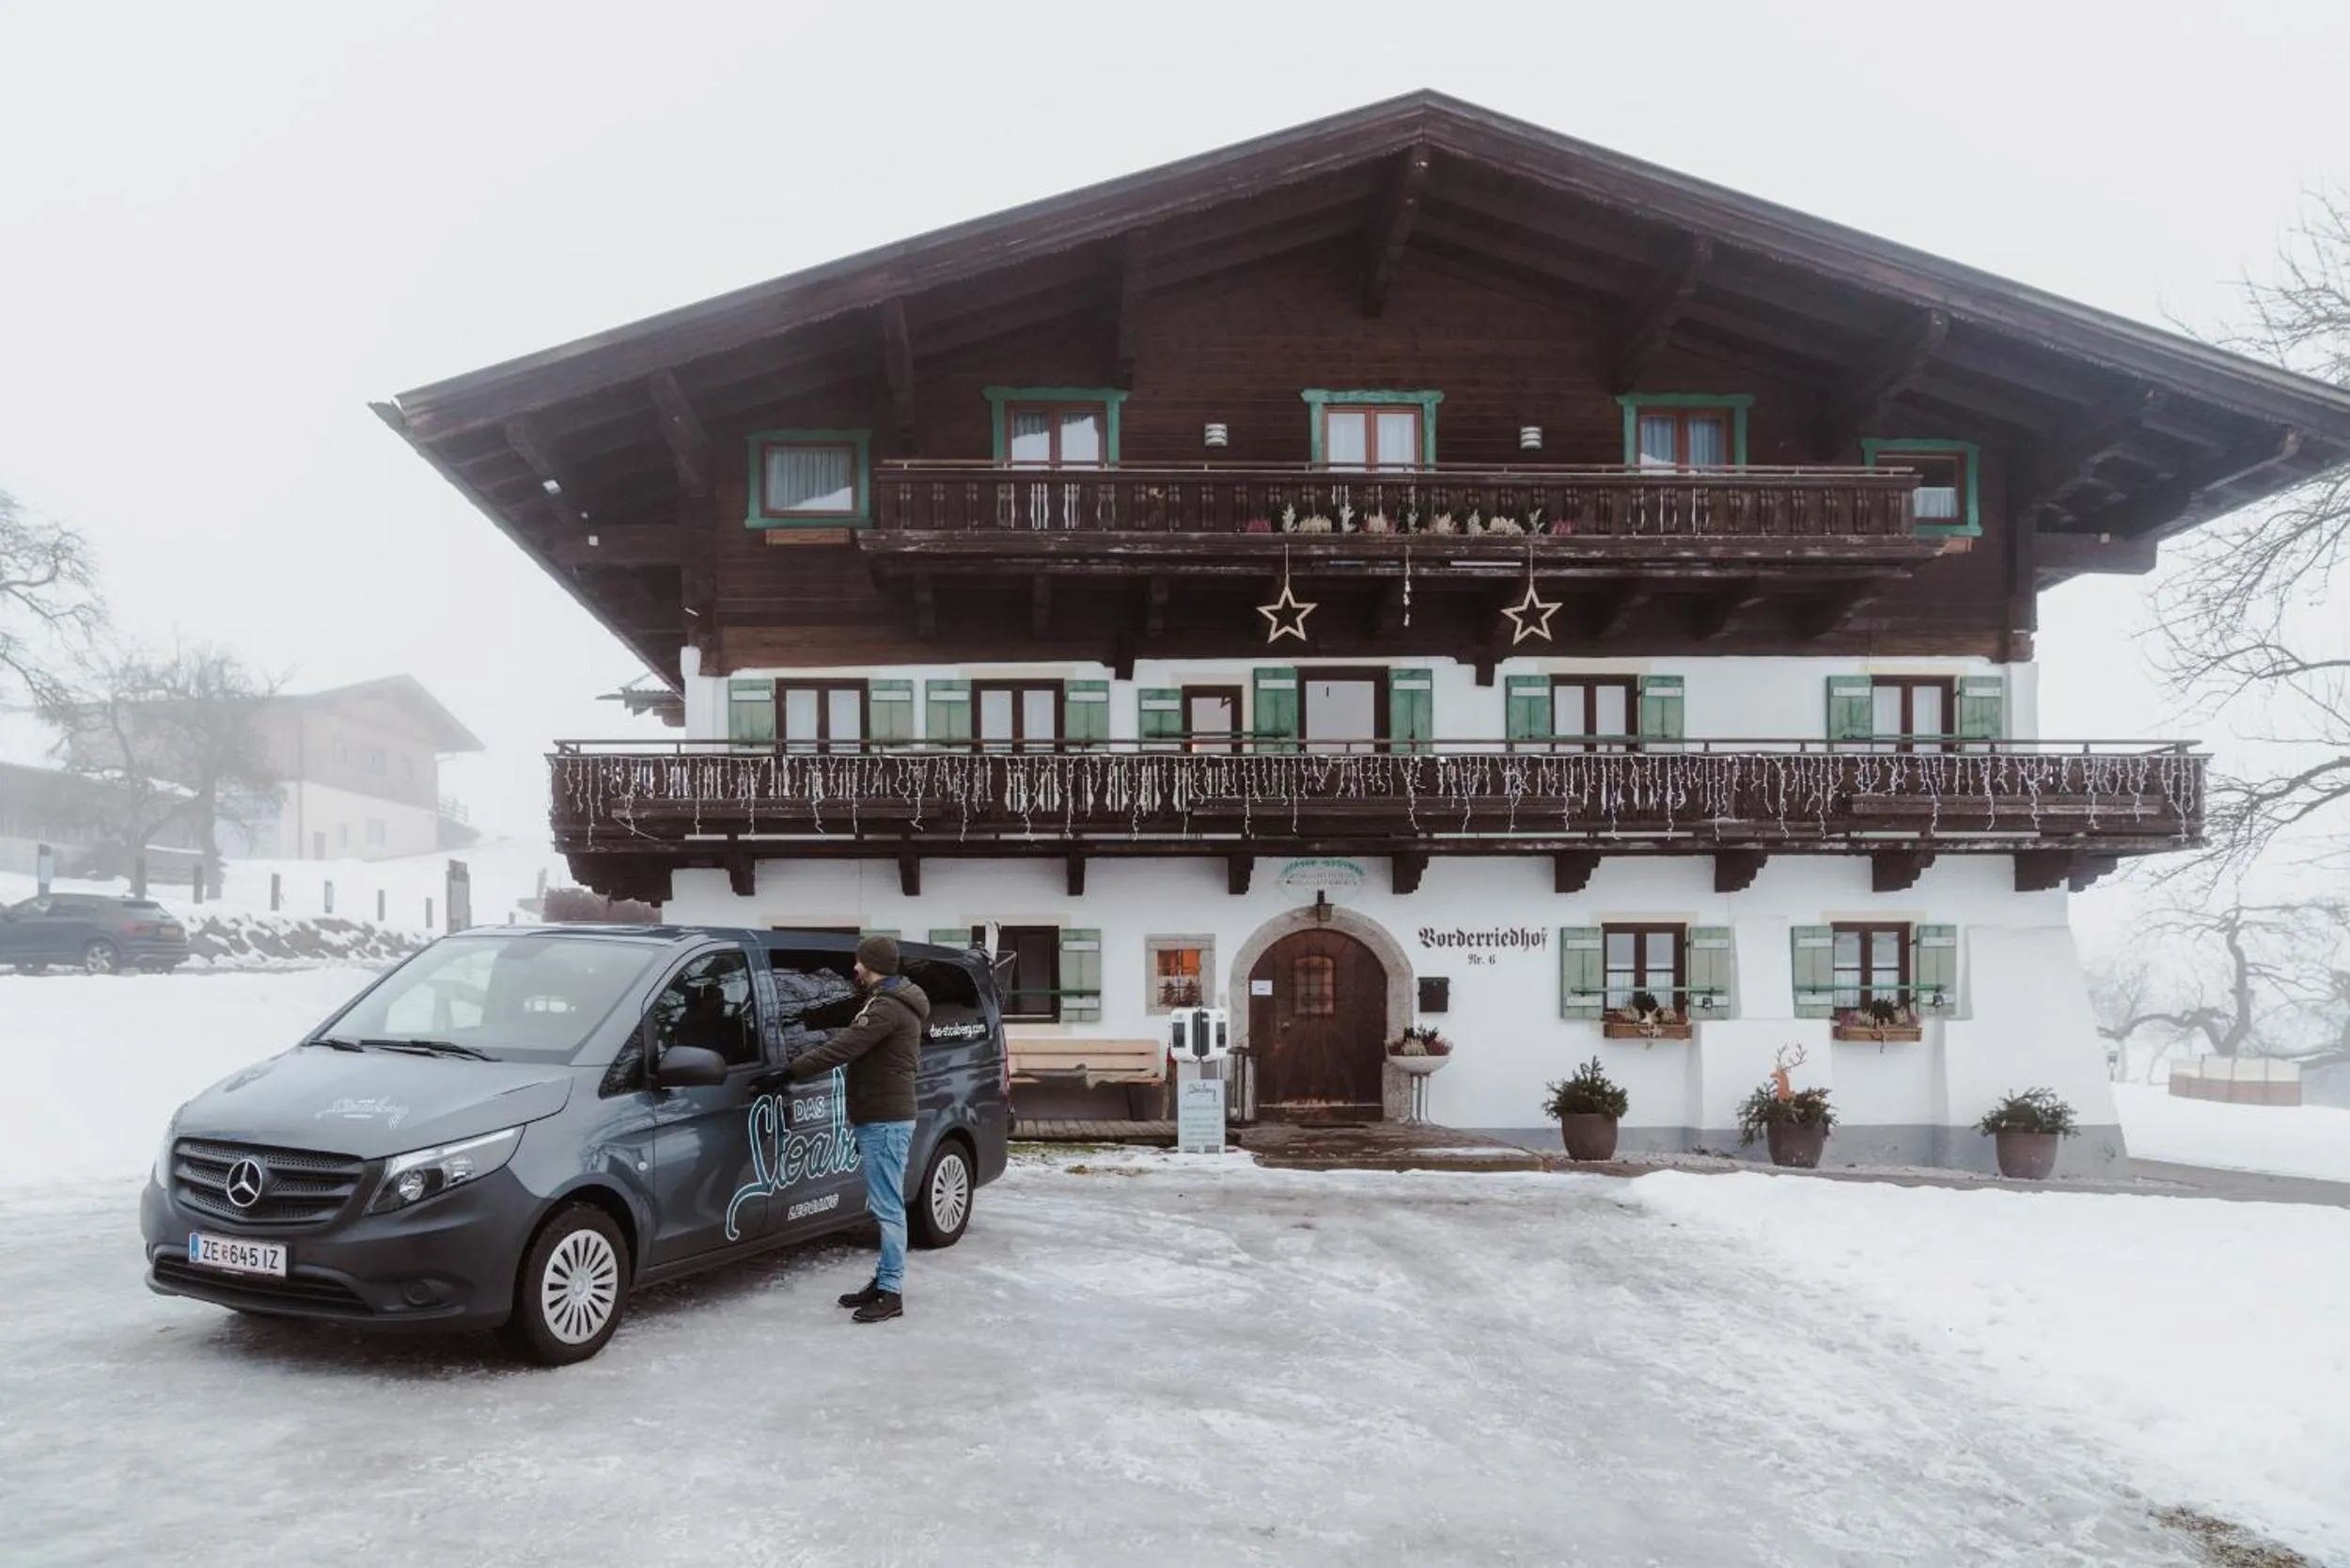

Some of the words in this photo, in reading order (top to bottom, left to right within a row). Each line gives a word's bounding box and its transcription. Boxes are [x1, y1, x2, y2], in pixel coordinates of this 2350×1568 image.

[1418, 926, 1547, 952] Vorderriedhof
[1467, 953, 1486, 965] Nr.
[792, 1095, 825, 1123] DAS
[202, 1240, 219, 1262] ZE
[229, 1245, 258, 1267] 645
